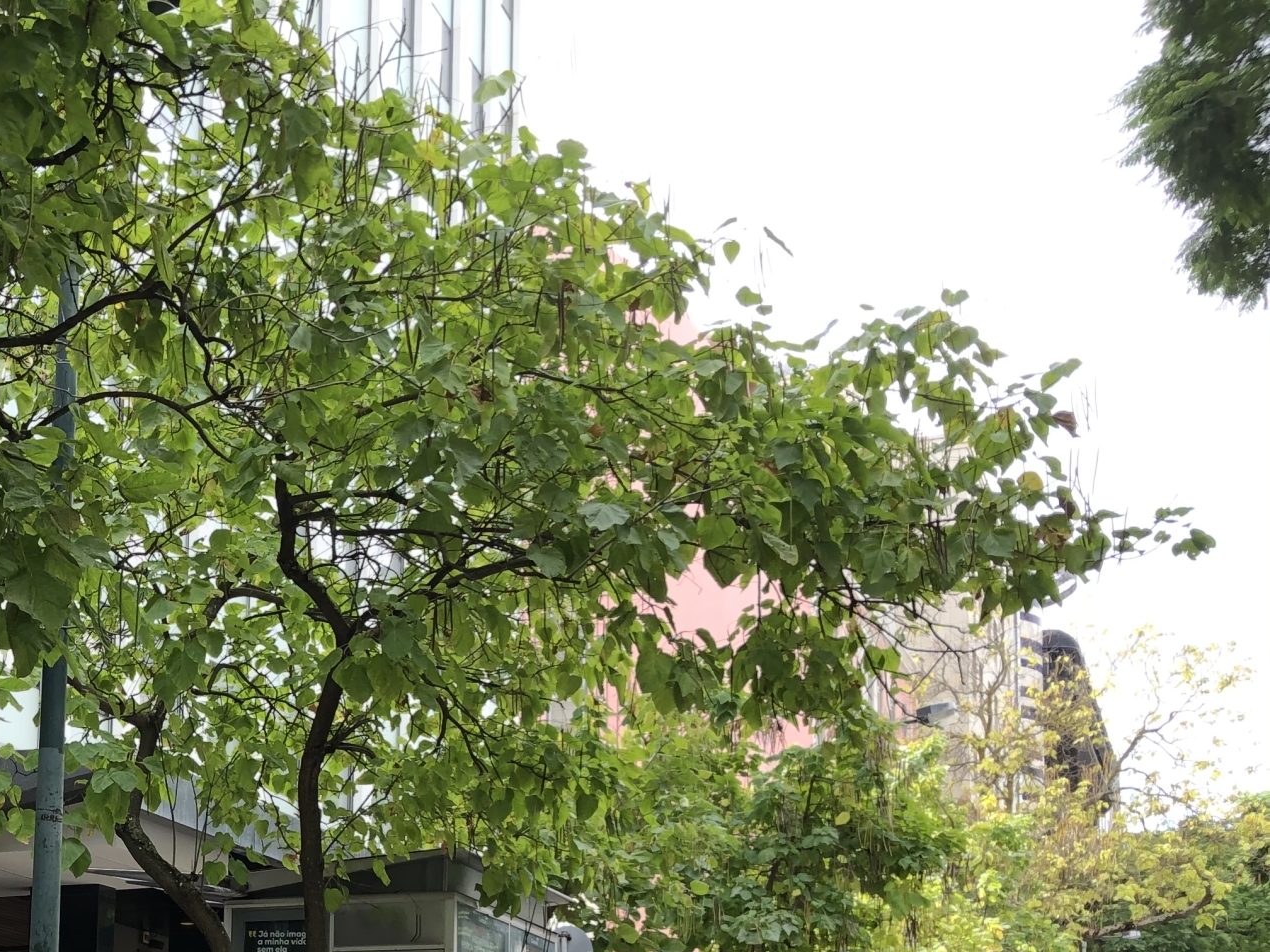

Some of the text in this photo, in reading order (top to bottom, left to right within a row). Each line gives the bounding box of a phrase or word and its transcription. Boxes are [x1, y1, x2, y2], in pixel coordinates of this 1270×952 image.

[258, 930, 268, 938] Já
[270, 930, 285, 938] não
[275, 945, 287, 952] ela
